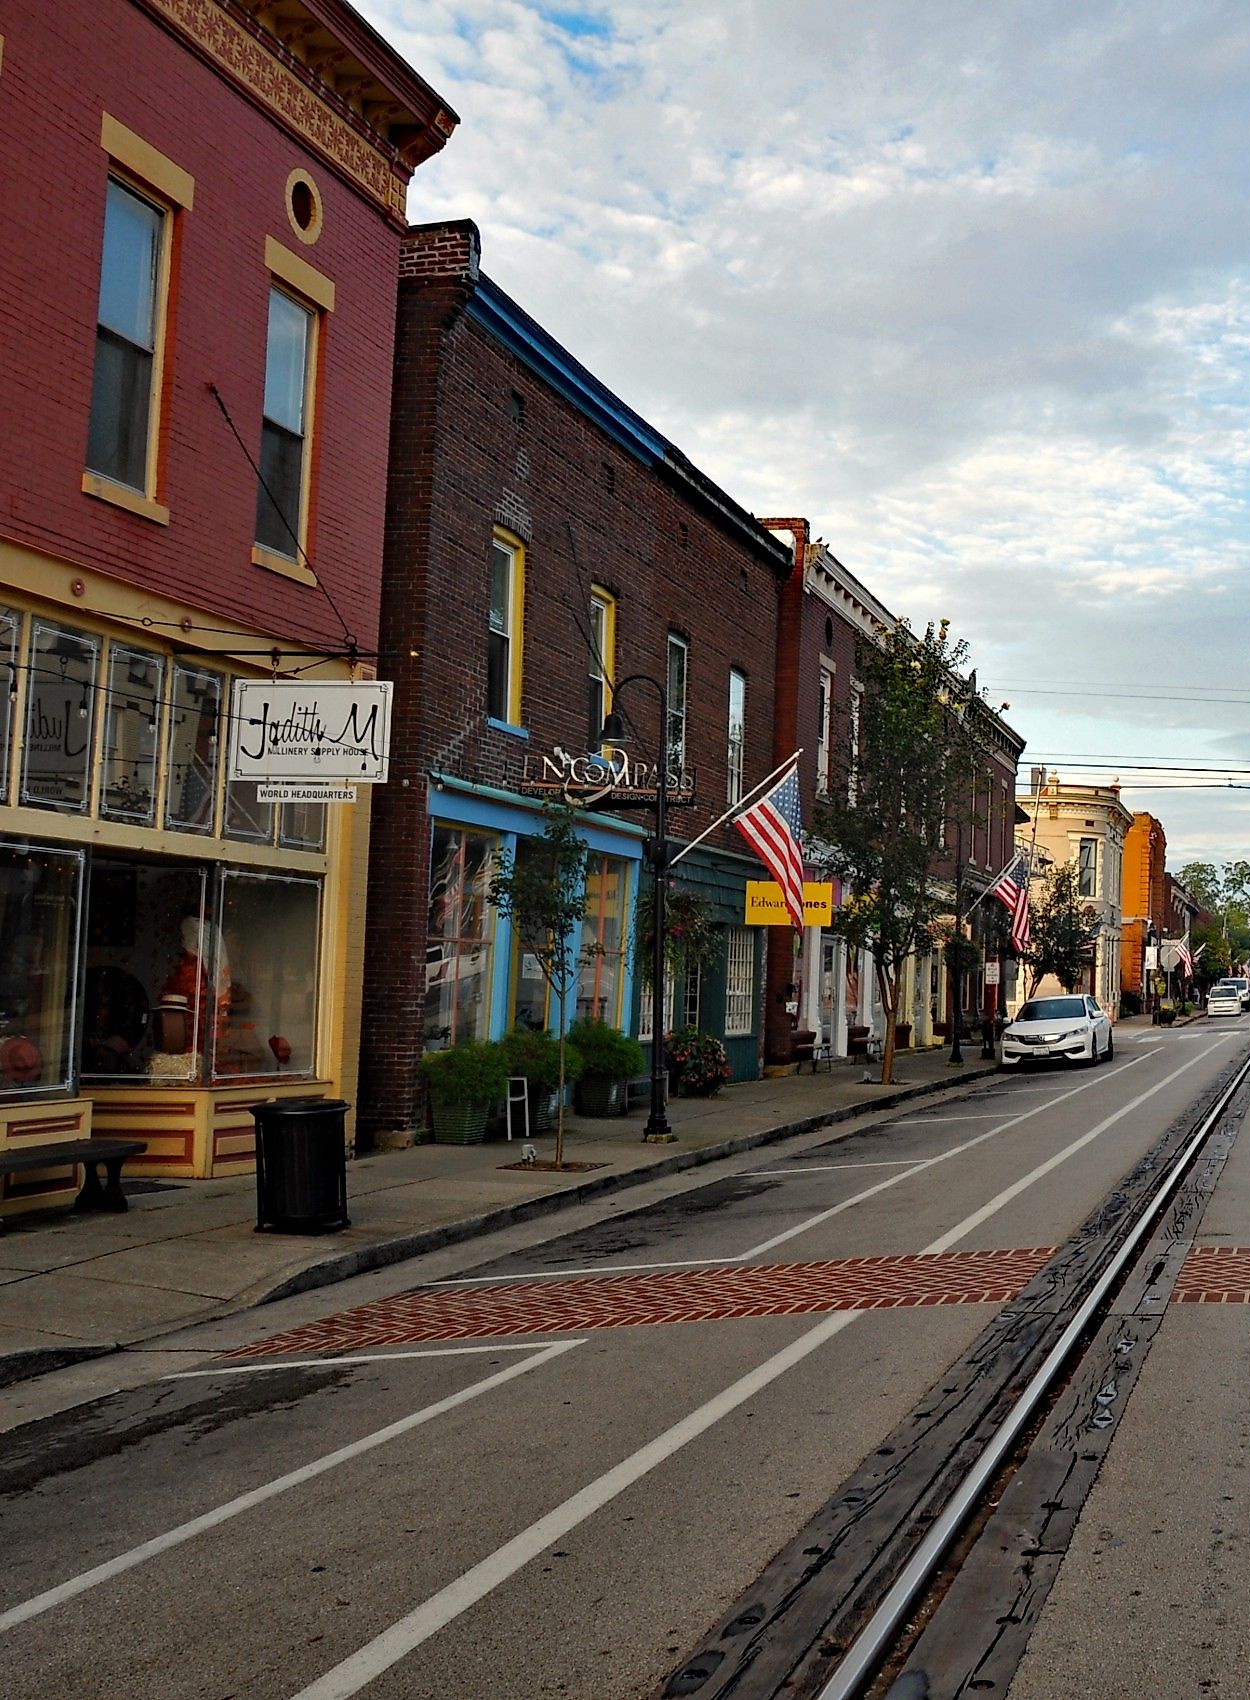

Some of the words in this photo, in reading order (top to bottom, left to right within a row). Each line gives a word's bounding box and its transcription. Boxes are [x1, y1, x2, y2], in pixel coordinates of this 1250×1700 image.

[241, 701, 327, 760] Judith
[330, 703, 379, 760] M
[267, 747, 308, 756] MLLINERY
[311, 747, 340, 756] SPPLY
[260, 790, 289, 798] WORLD
[291, 790, 354, 799] HEADQUARTERS
